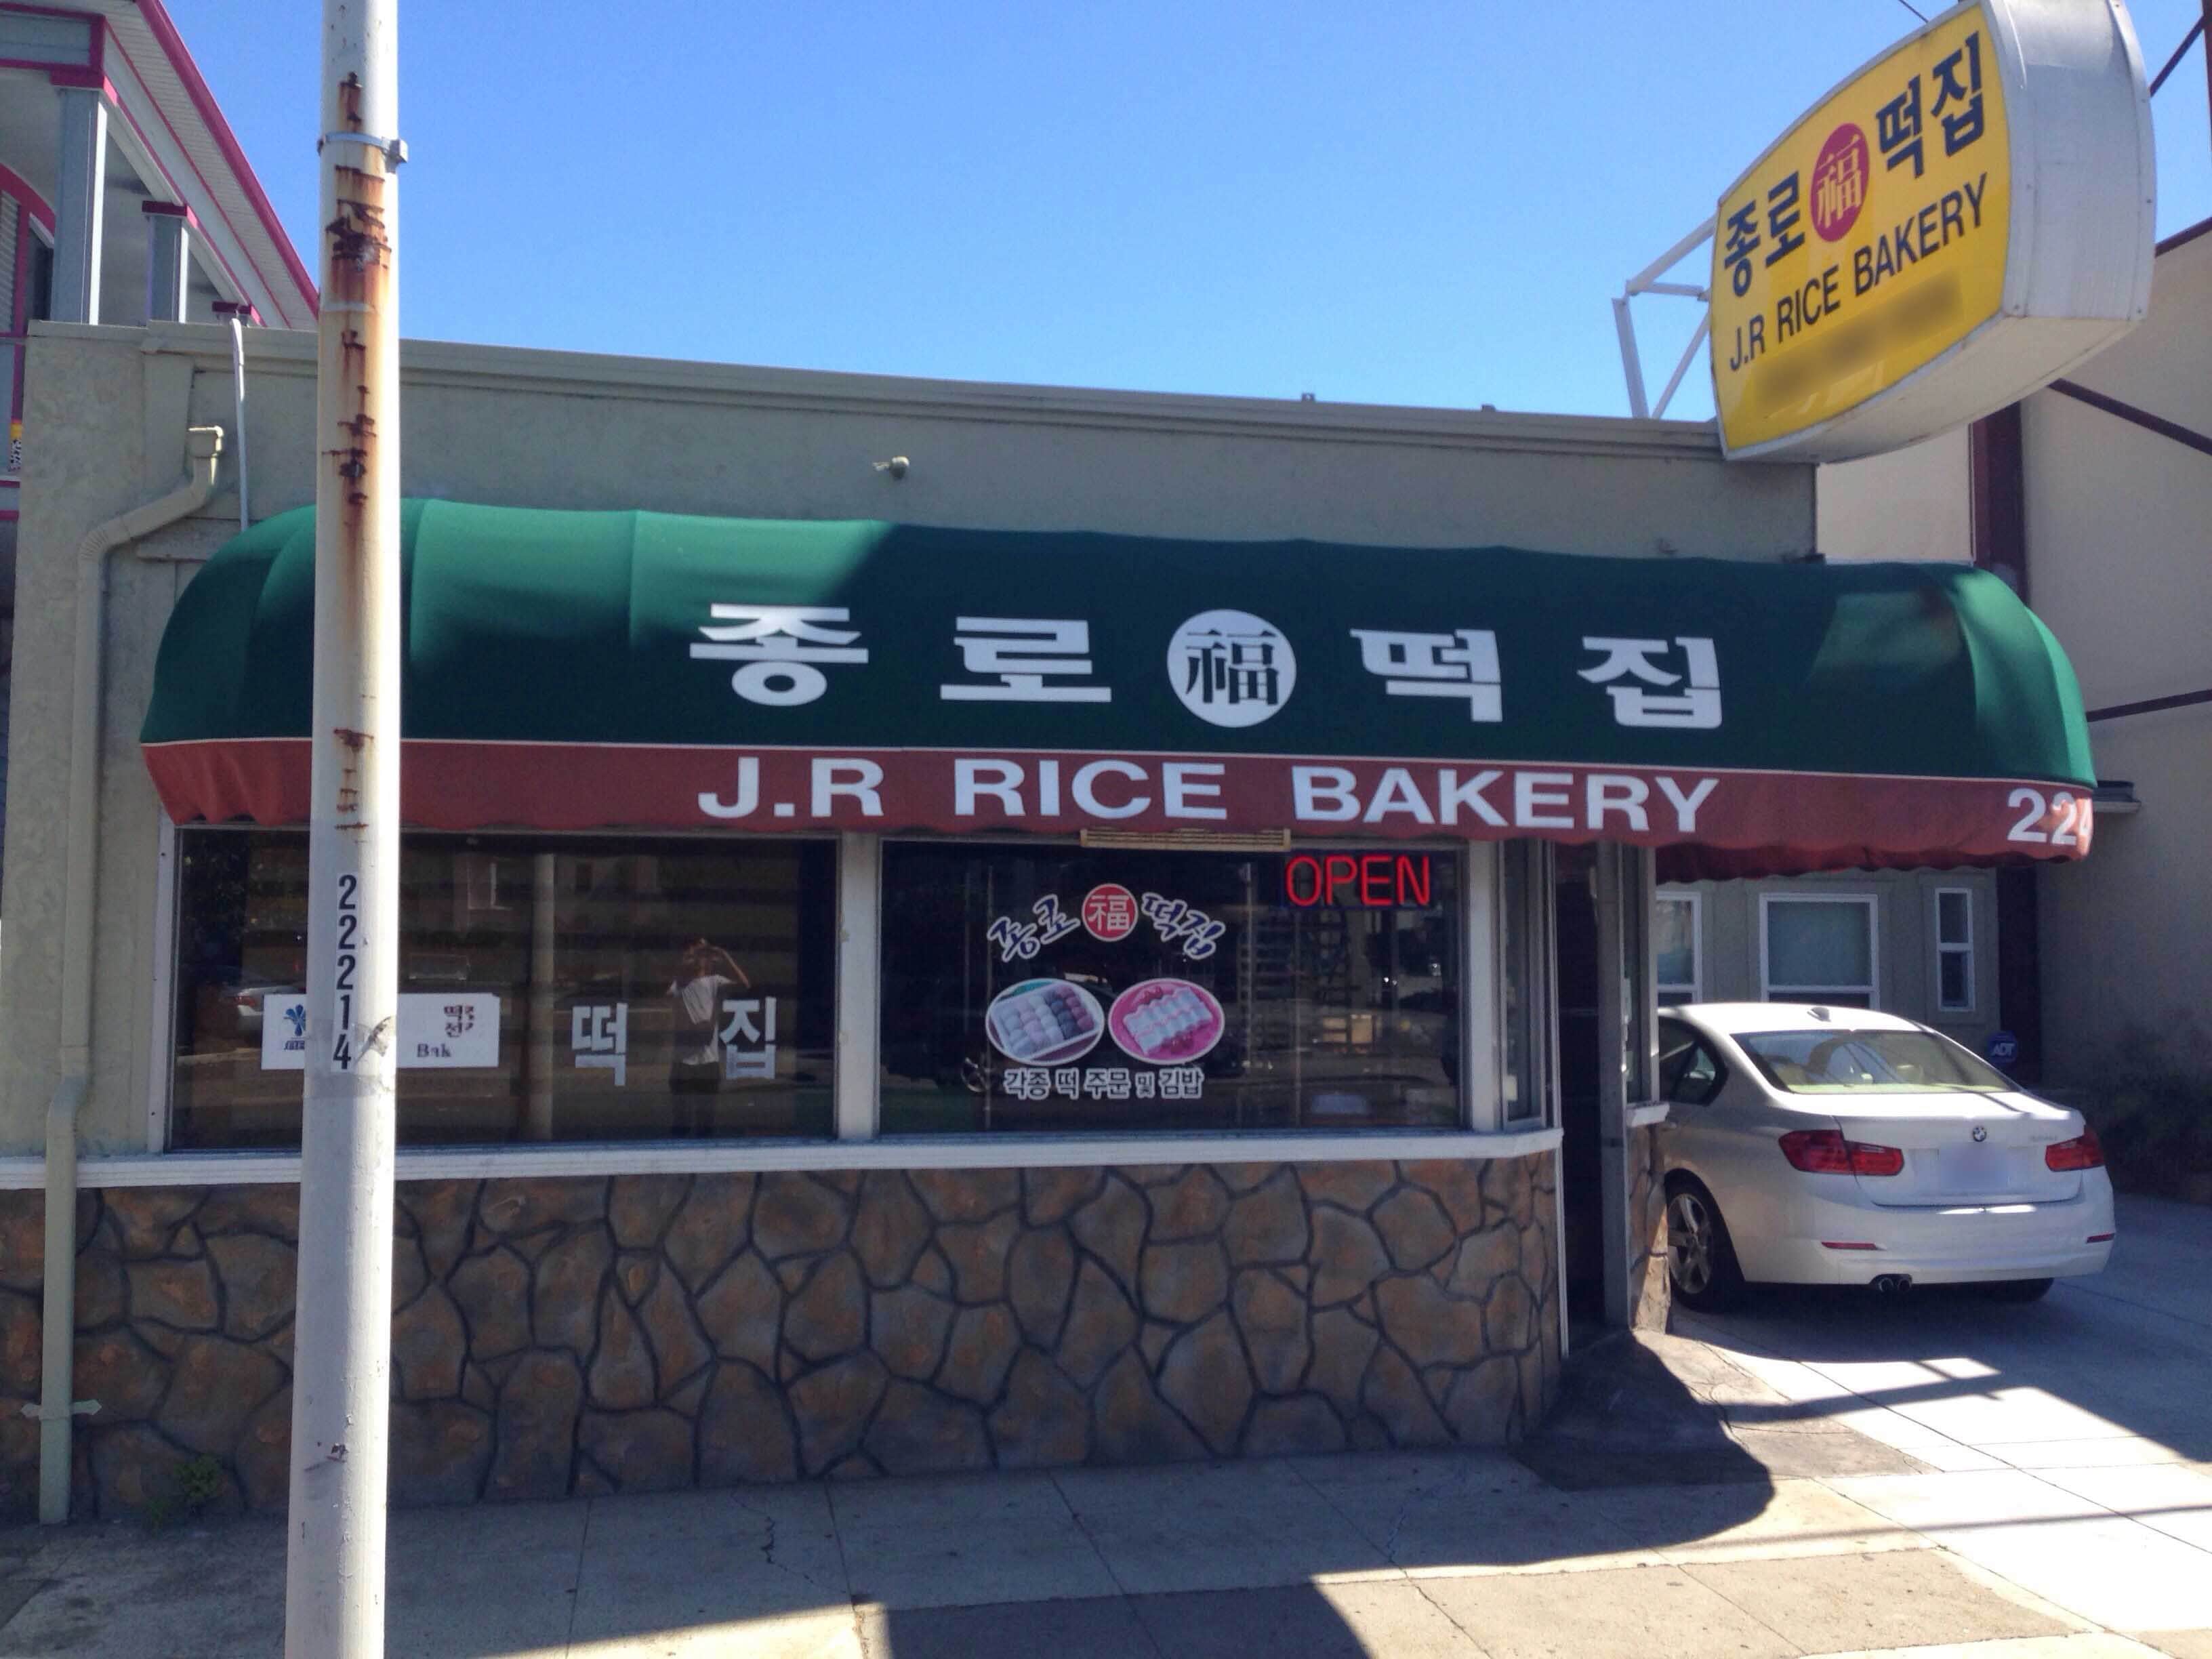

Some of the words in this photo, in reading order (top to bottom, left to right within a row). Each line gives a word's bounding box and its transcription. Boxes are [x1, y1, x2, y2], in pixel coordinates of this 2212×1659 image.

[1724, 171, 1805, 298] 종로
[1875, 30, 1985, 180] 떡집
[1729, 313, 1766, 372] J.R
[1777, 264, 1841, 344] RICE
[1853, 171, 1988, 298] BAKERY
[697, 756, 884, 819] J.R
[954, 758, 1228, 820] RICE
[1292, 765, 1719, 832] BAKERY
[1286, 854, 1431, 907] OPEN
[1088, 894, 1131, 932] 福
[1990, 1042, 2015, 1057] ADT
[1003, 1067, 1051, 1101] 각종
[1054, 1067, 1080, 1101] 떡
[1084, 1067, 1131, 1099] 주문
[1158, 1067, 1205, 1099] 김밥
